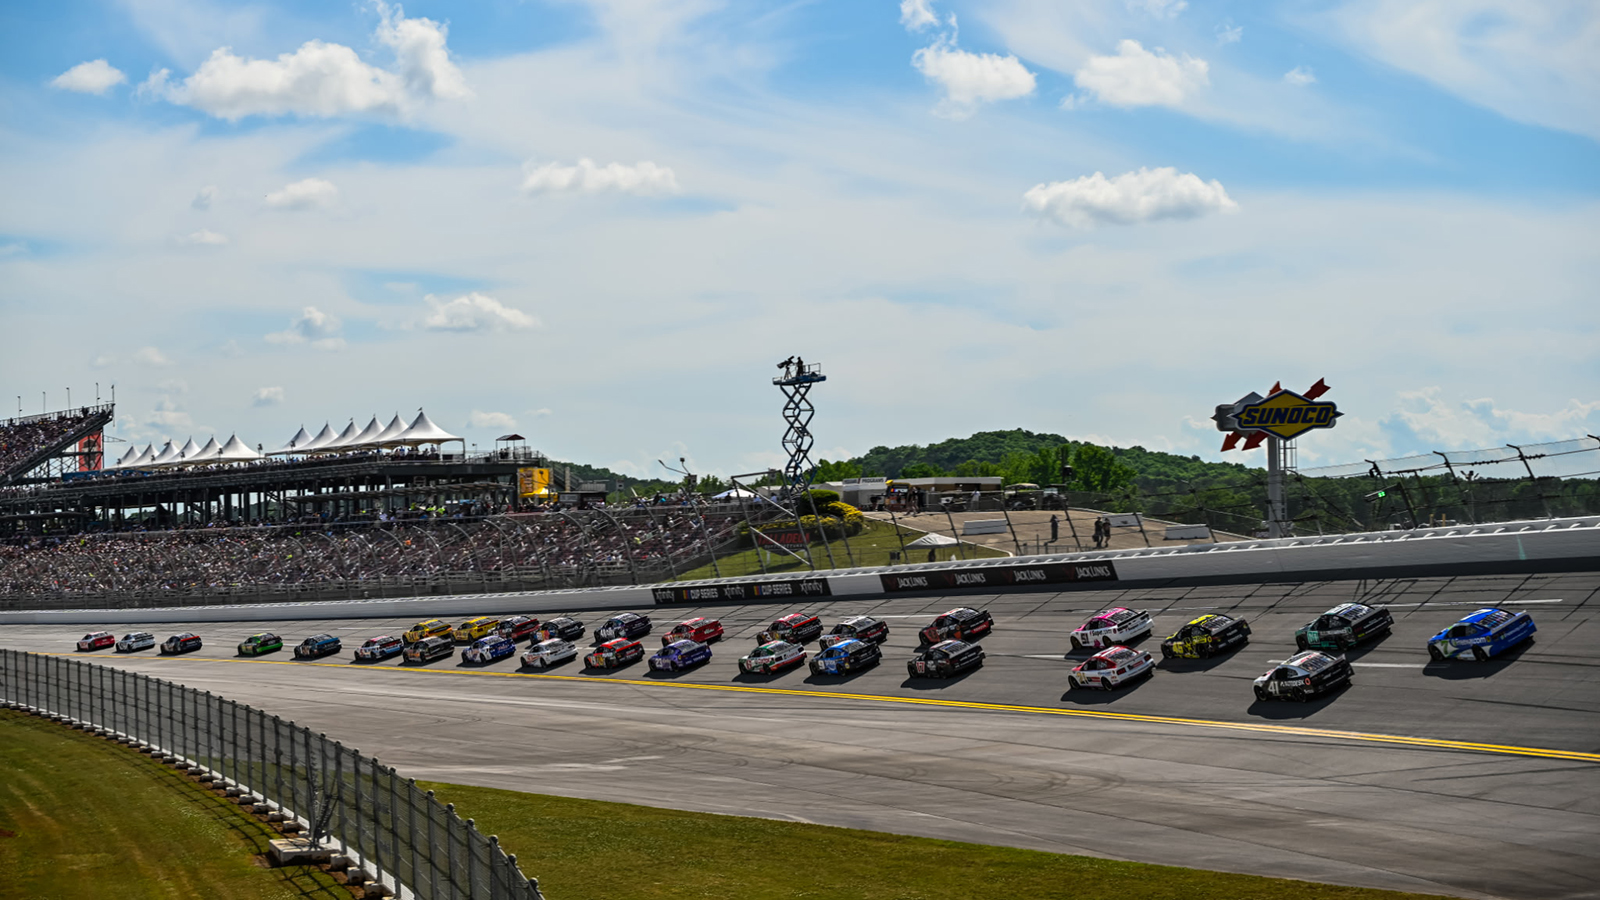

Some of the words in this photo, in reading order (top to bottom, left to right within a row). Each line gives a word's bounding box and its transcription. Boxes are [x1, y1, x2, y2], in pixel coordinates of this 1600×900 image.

[1243, 406, 1332, 425] SUNOCO
[723, 585, 745, 599] xfinity
[799, 580, 823, 595] xfinity
[655, 588, 675, 602] xfinity
[1080, 632, 1090, 645] 51
[1440, 640, 1449, 655] 7
[818, 659, 826, 670] 9
[1268, 680, 1280, 695] 41
